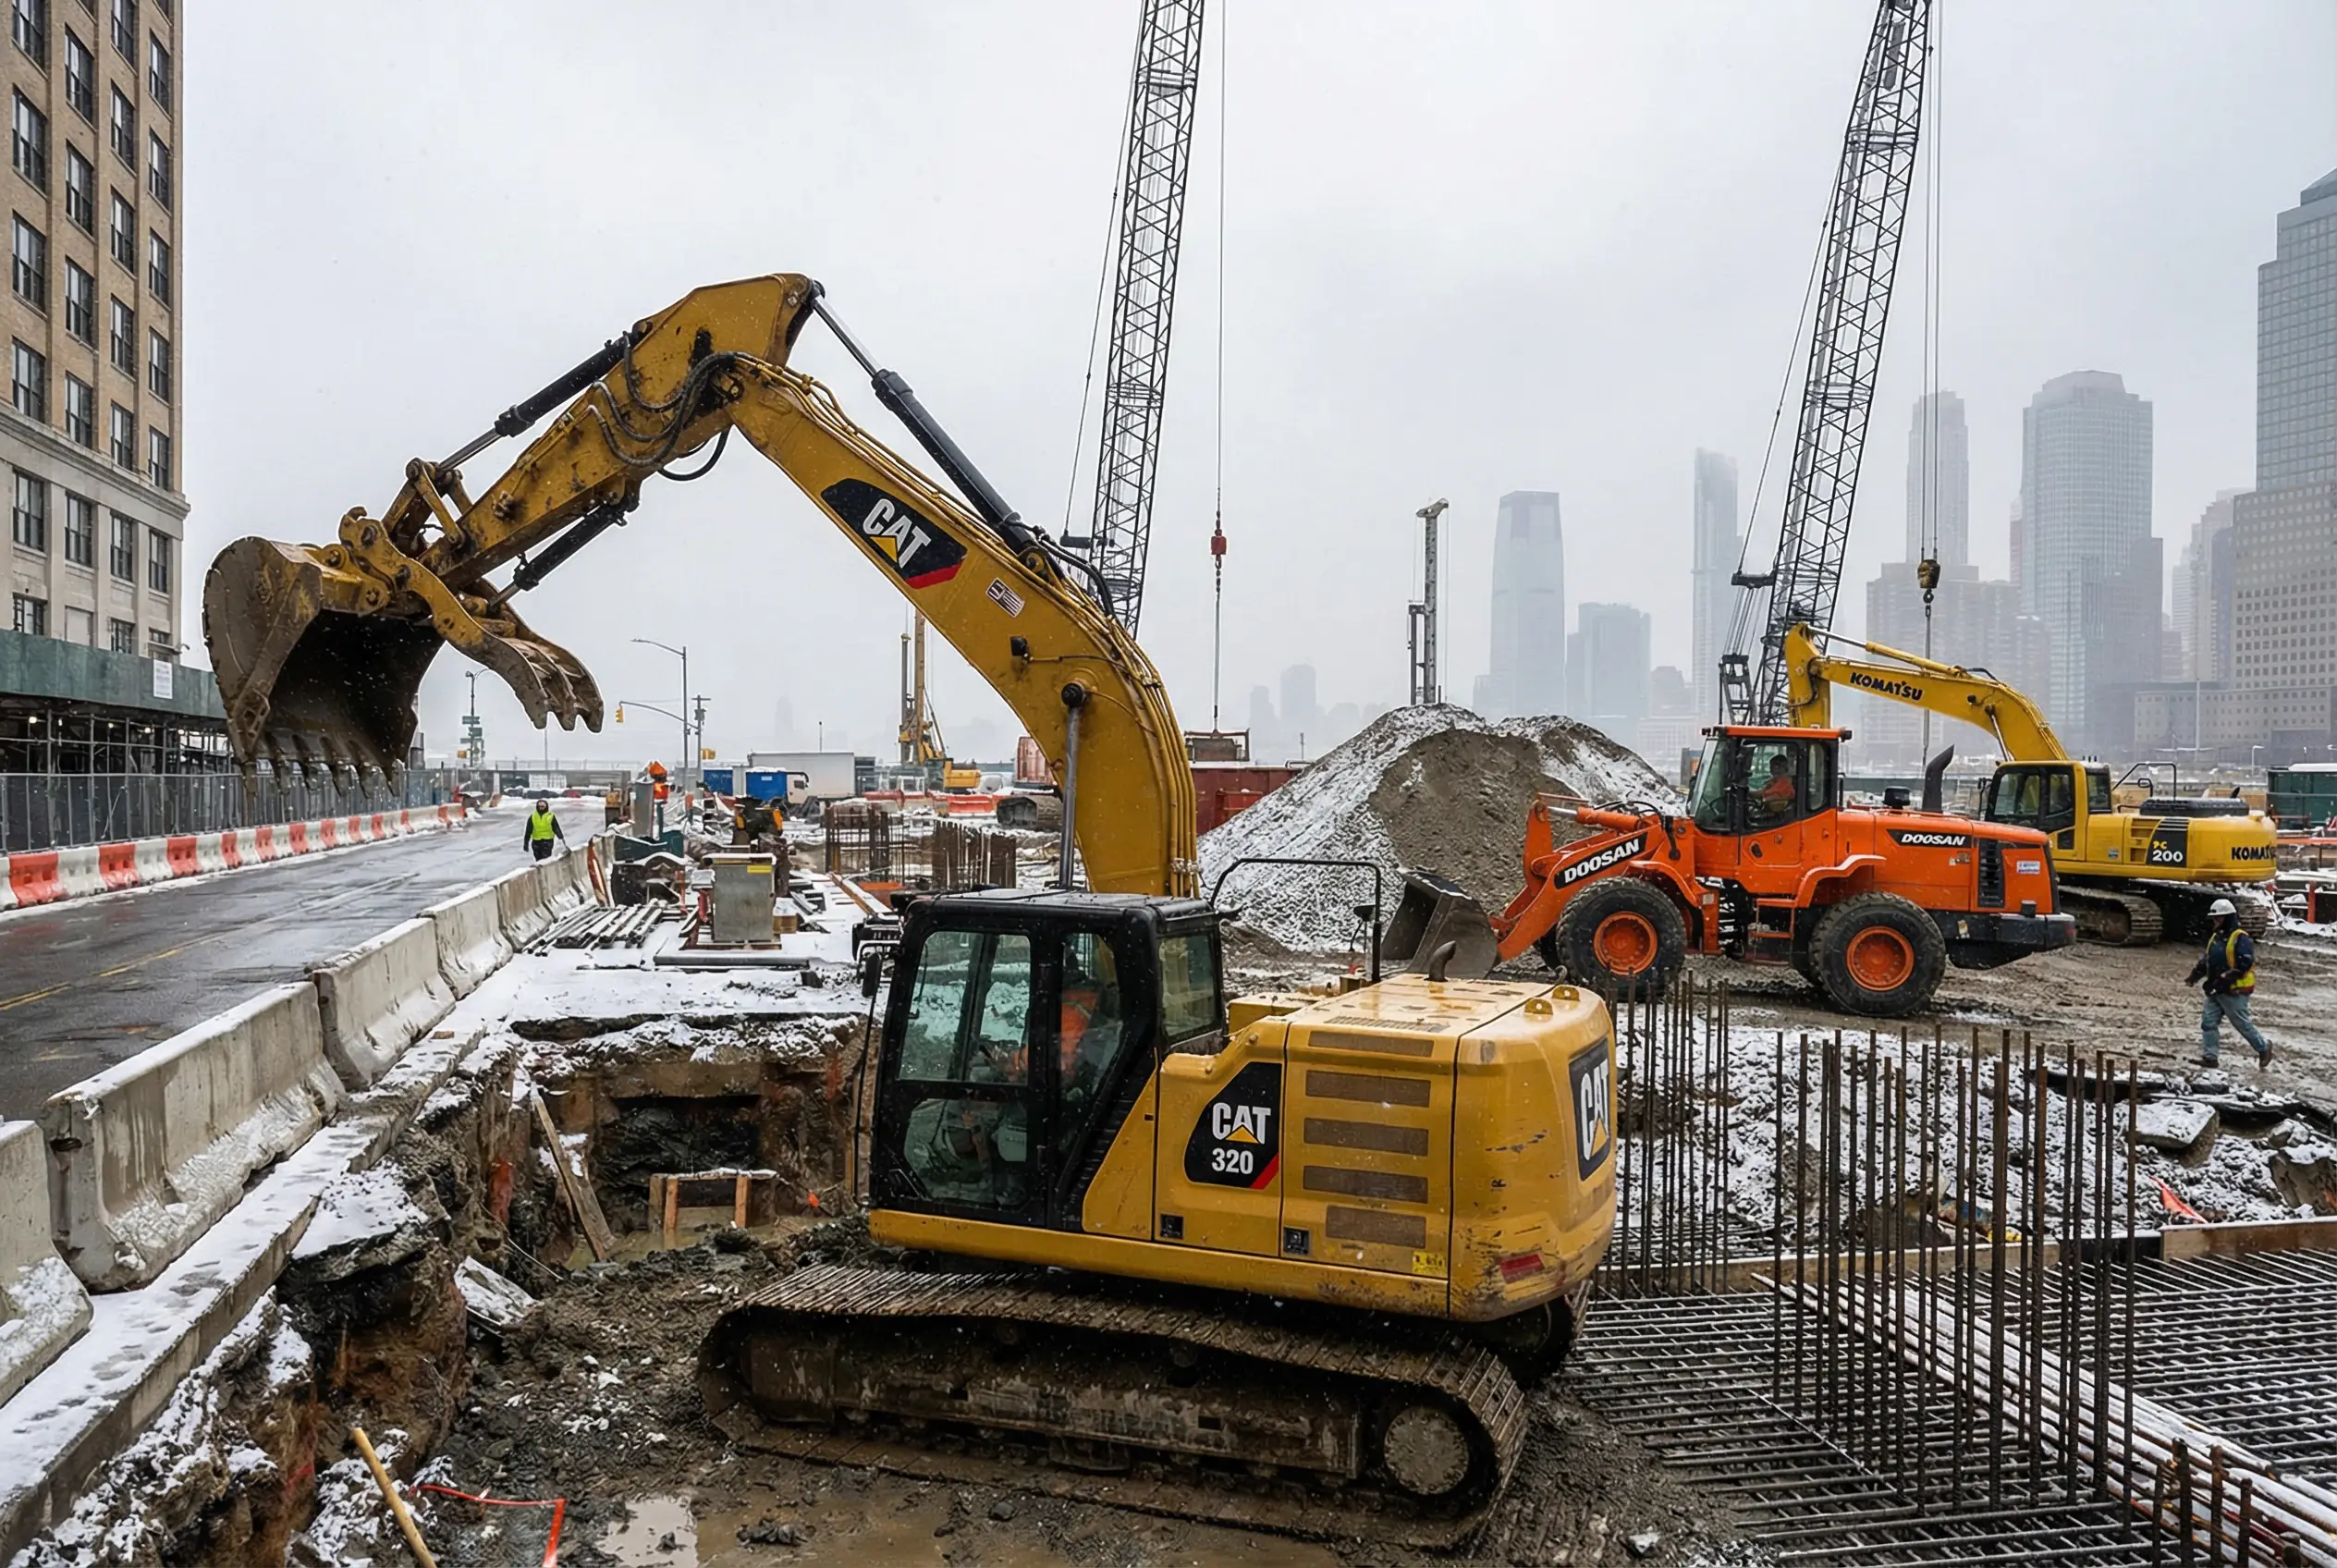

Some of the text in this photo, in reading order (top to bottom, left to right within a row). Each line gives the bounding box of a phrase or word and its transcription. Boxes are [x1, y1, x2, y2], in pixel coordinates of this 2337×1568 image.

[863, 498, 932, 569] CAT
[1850, 672, 1923, 701] KOMATSU
[1902, 833, 1965, 846] DOOSAN
[2152, 850, 2184, 863] 200
[1564, 839, 1640, 883] DOOSAN
[1212, 1102, 1271, 1145] CAT
[1581, 1058, 1609, 1161] CAT
[1211, 1147, 1254, 1175] 320
